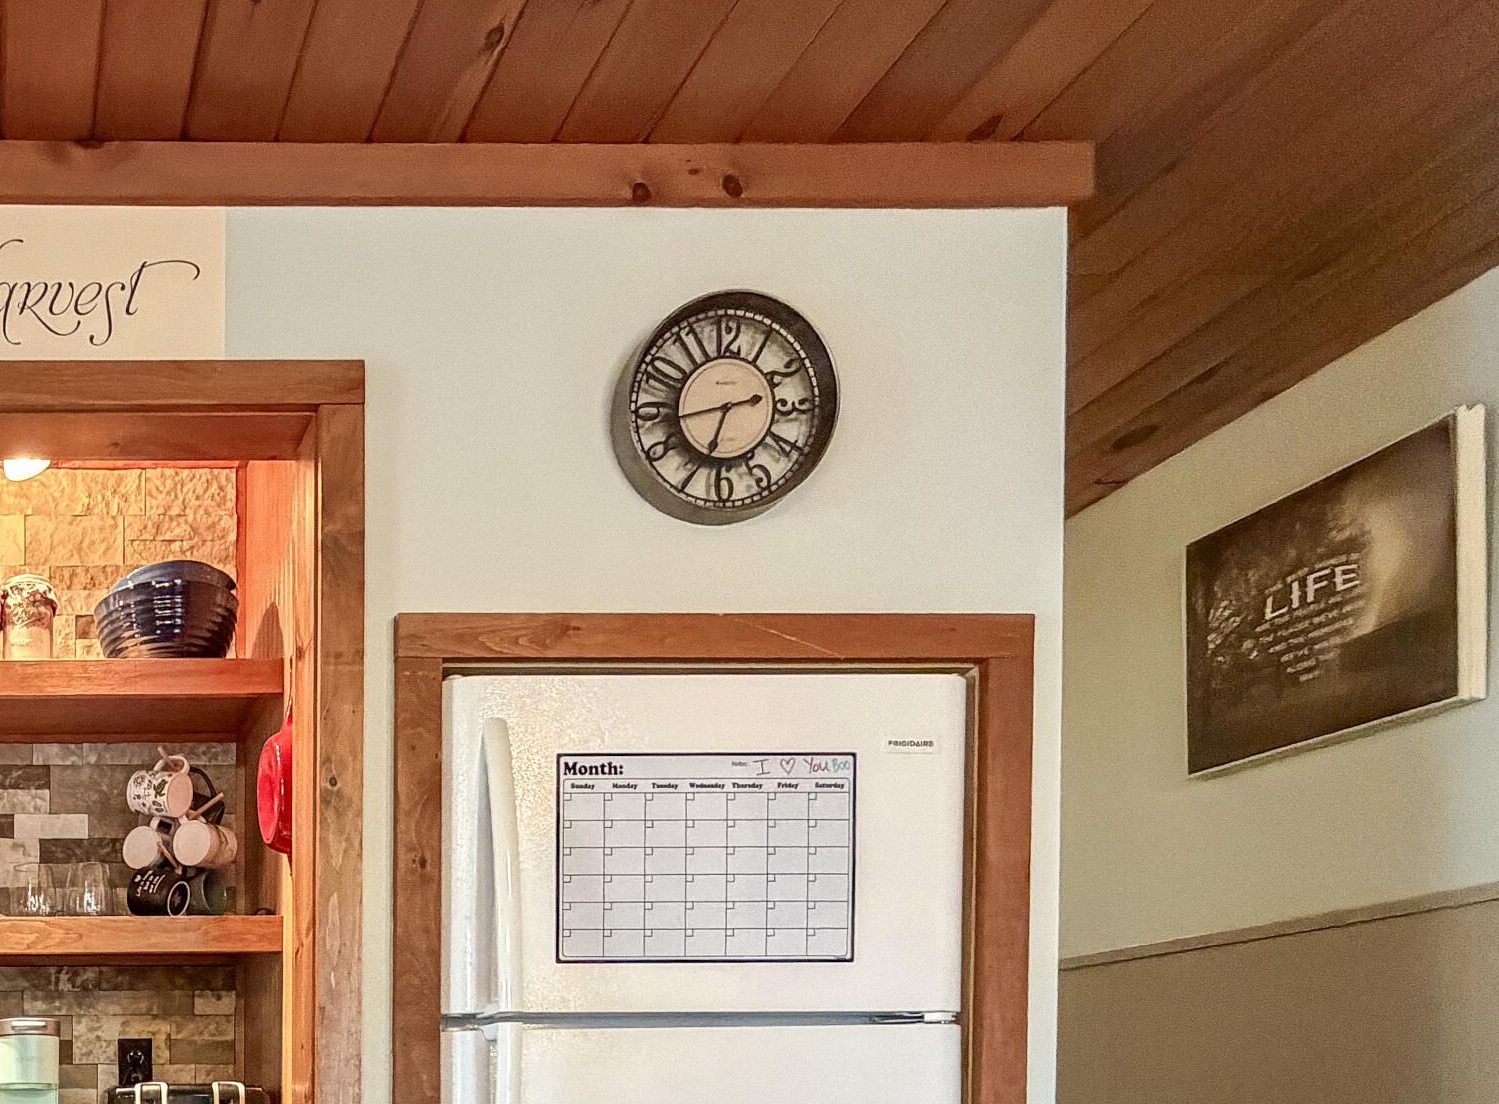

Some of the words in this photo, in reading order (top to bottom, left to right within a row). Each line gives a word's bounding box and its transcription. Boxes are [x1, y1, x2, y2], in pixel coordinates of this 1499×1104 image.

[715, 317, 742, 356] 12
[751, 329, 773, 363] 1
[646, 355, 688, 388] 10
[764, 357, 802, 388] 2
[776, 397, 815, 417] 3
[714, 463, 735, 501] 6
[1265, 563, 1361, 620] LIFE
[563, 761, 624, 776] Month:
[752, 758, 770, 776] I
[803, 757, 830, 774] You
[570, 782, 595, 790] Sunday
[612, 782, 638, 790] Monday
[652, 782, 678, 790] Tuesday
[689, 782, 725, 790] Wednesday
[731, 782, 763, 790] Thursday
[777, 782, 799, 790] Friday
[814, 782, 845, 790] Saturday
